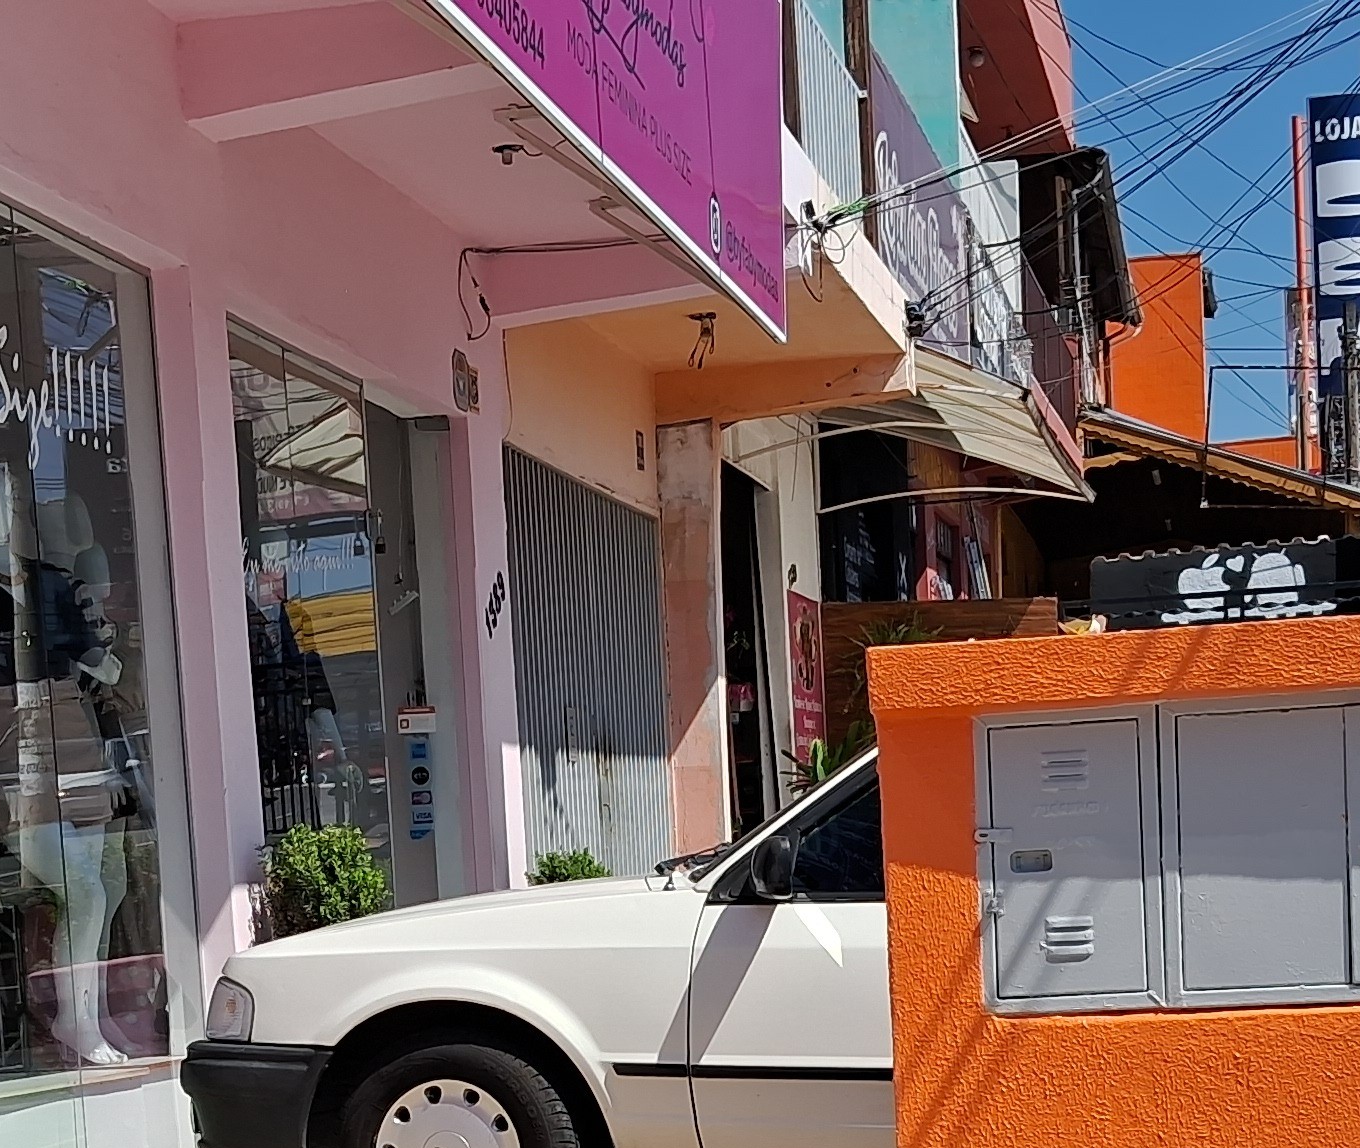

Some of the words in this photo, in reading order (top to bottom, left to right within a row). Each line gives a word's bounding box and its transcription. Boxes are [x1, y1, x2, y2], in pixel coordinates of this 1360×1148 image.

[566, 18, 598, 79] MODA
[601, 60, 649, 137] FEMININA
[649, 114, 673, 166] PLUS
[673, 140, 693, 188] SIZE
[415, 811, 433, 821] VISA
